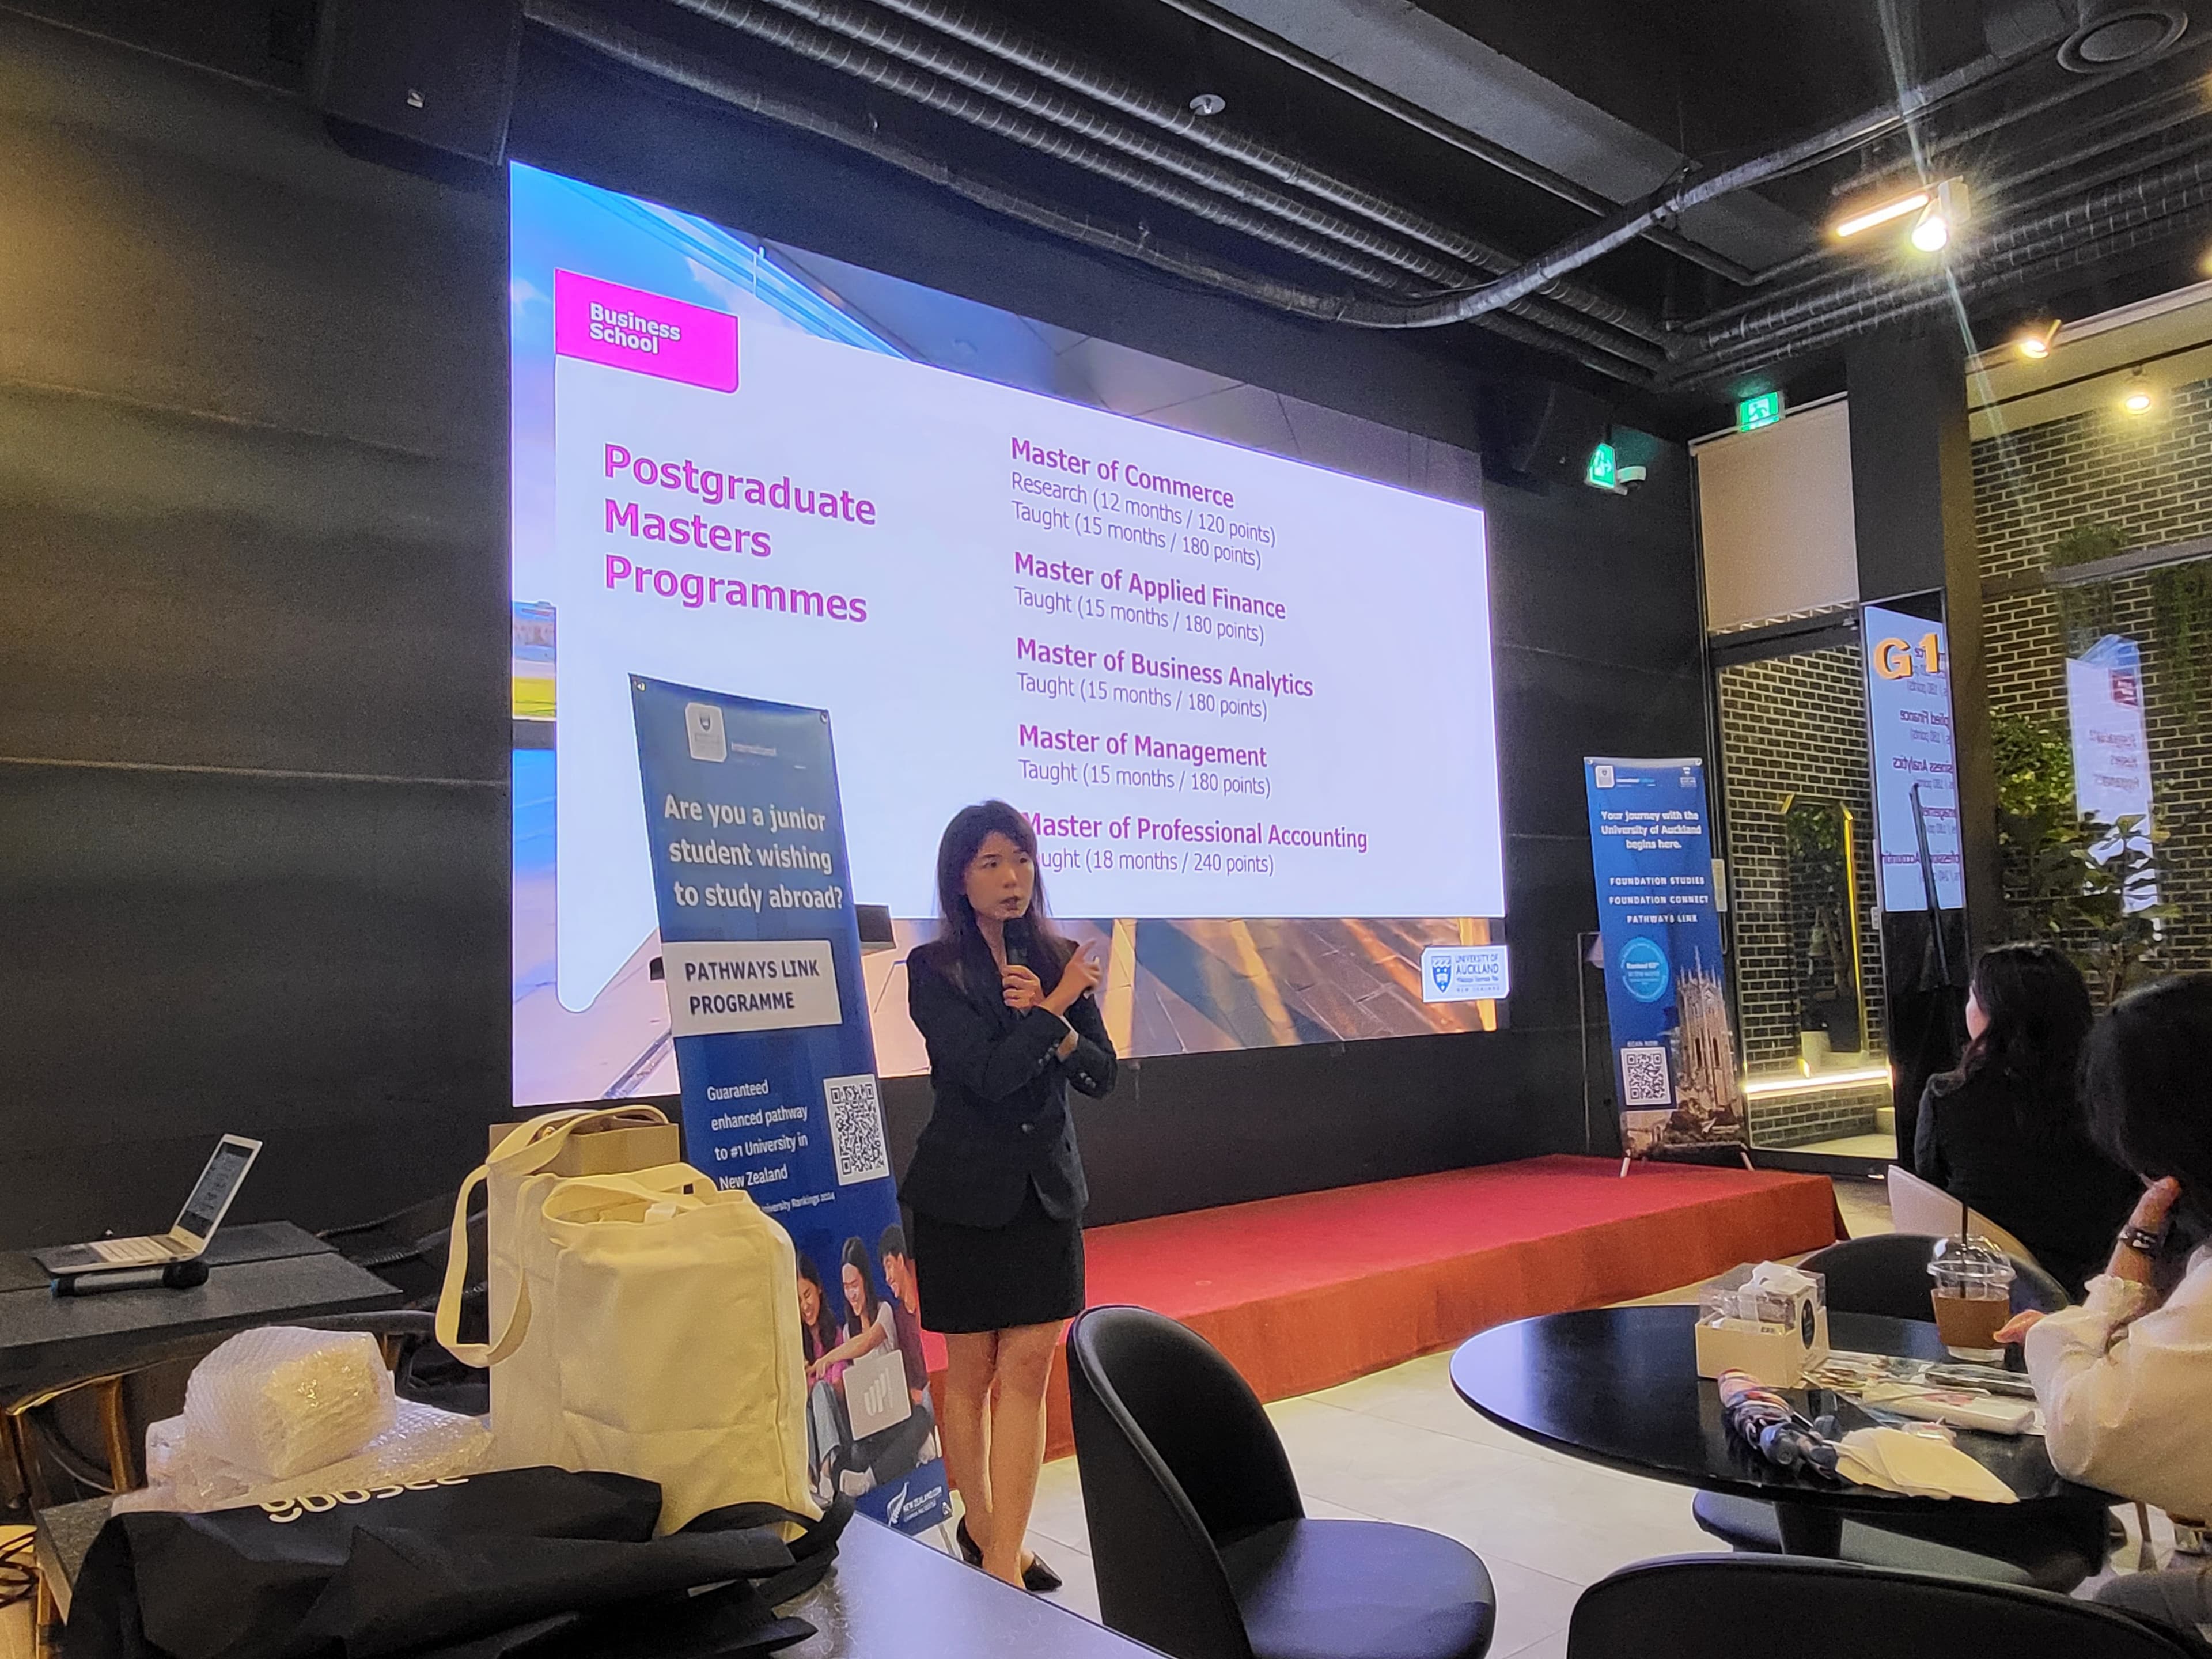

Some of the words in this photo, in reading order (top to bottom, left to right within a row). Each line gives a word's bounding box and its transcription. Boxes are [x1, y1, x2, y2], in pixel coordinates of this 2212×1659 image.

[590, 302, 681, 341] Business
[590, 323, 658, 354] School
[604, 443, 876, 525] Postgraduate
[1012, 437, 1090, 475] Master
[1097, 459, 1119, 481] of
[1125, 466, 1234, 509] Commerce
[605, 499, 771, 556] Masters
[1012, 472, 1087, 505] Research
[1093, 487, 1118, 511] (12
[1126, 497, 1182, 525] months
[1186, 510, 1194, 528] /
[1198, 514, 1224, 534] 120
[1229, 520, 1275, 548] points)
[1012, 501, 1069, 530] Taught
[1075, 513, 1102, 536] (15
[1108, 521, 1165, 548] months
[1170, 533, 1177, 553] /
[1183, 536, 1209, 556] 180
[1214, 542, 1261, 571] points)
[605, 554, 867, 622] Programmes
[1015, 552, 1094, 586] Master
[1101, 569, 1123, 591] of
[1129, 573, 1206, 607] Applied
[1213, 587, 1286, 619] Finance
[1014, 586, 1072, 615] Taught
[1078, 597, 1105, 619] (15
[1111, 604, 1168, 628] months
[1173, 612, 1180, 632] /
[1185, 615, 1211, 634] 180
[1217, 619, 1264, 646] points)
[1017, 637, 1096, 669] Master
[1104, 651, 1125, 672] of
[1132, 653, 1222, 685] Business
[1229, 666, 1313, 698] Analytics
[1874, 634, 1938, 680] G1
[1016, 672, 1074, 699] Taught
[1080, 680, 1108, 703] (15
[1113, 684, 1171, 708] months
[1175, 691, 1183, 711] /
[1188, 693, 1215, 712] 180
[1220, 697, 1267, 722] points)
[1020, 724, 1100, 753] Master
[1106, 733, 1128, 755] of
[1135, 735, 1267, 768] Management
[1019, 759, 1077, 785] Taught
[1082, 764, 1110, 787] (15
[1116, 768, 1175, 789] months
[1179, 772, 1185, 792] /
[1191, 774, 1218, 792] 180
[1223, 777, 1271, 798] points)
[664, 793, 702, 820] Are
[707, 802, 745, 828] you
[752, 809, 764, 825] a
[770, 804, 825, 832] junior
[1601, 811, 1623, 820] Your
[1626, 810, 1660, 821] journey
[1662, 810, 1681, 820] with
[1684, 811, 1698, 820] the
[1109, 816, 1130, 839] of
[1138, 818, 1262, 844] Professional
[1268, 824, 1367, 853] Accounting
[1601, 825, 1647, 836] University
[1650, 825, 1659, 834] of
[1662, 825, 1701, 834] Auckland
[1626, 839, 1656, 850] begins
[669, 839, 752, 866] student
[757, 844, 832, 874] wishing
[1038, 848, 1080, 872] ught
[1086, 850, 1113, 873] (18
[1119, 851, 1177, 871] months
[1181, 853, 1189, 873] /
[1194, 853, 1221, 871] 240
[1226, 854, 1274, 878] points)
[674, 881, 698, 906] to
[705, 882, 762, 912] study
[769, 885, 843, 909] abroad?
[1670, 877, 1704, 885] STUDIES
[1670, 895, 1709, 903] CONNECT
[1627, 915, 1674, 923] PATHWAYS
[685, 960, 777, 981] PATHWAYS
[782, 959, 819, 977] LINK
[1456, 963, 1499, 975] AUCKLAND
[690, 991, 794, 1015] PROGRAMME
[707, 1079, 769, 1101] Guaranteed
[711, 1111, 763, 1131] enhanced
[766, 1105, 808, 1127] pathway
[715, 1147, 728, 1161] to
[730, 1145, 743, 1158] #1
[745, 1137, 796, 1158] University
[798, 1132, 808, 1147] in
[719, 1173, 745, 1191] New
[746, 1164, 787, 1187] Zealand
